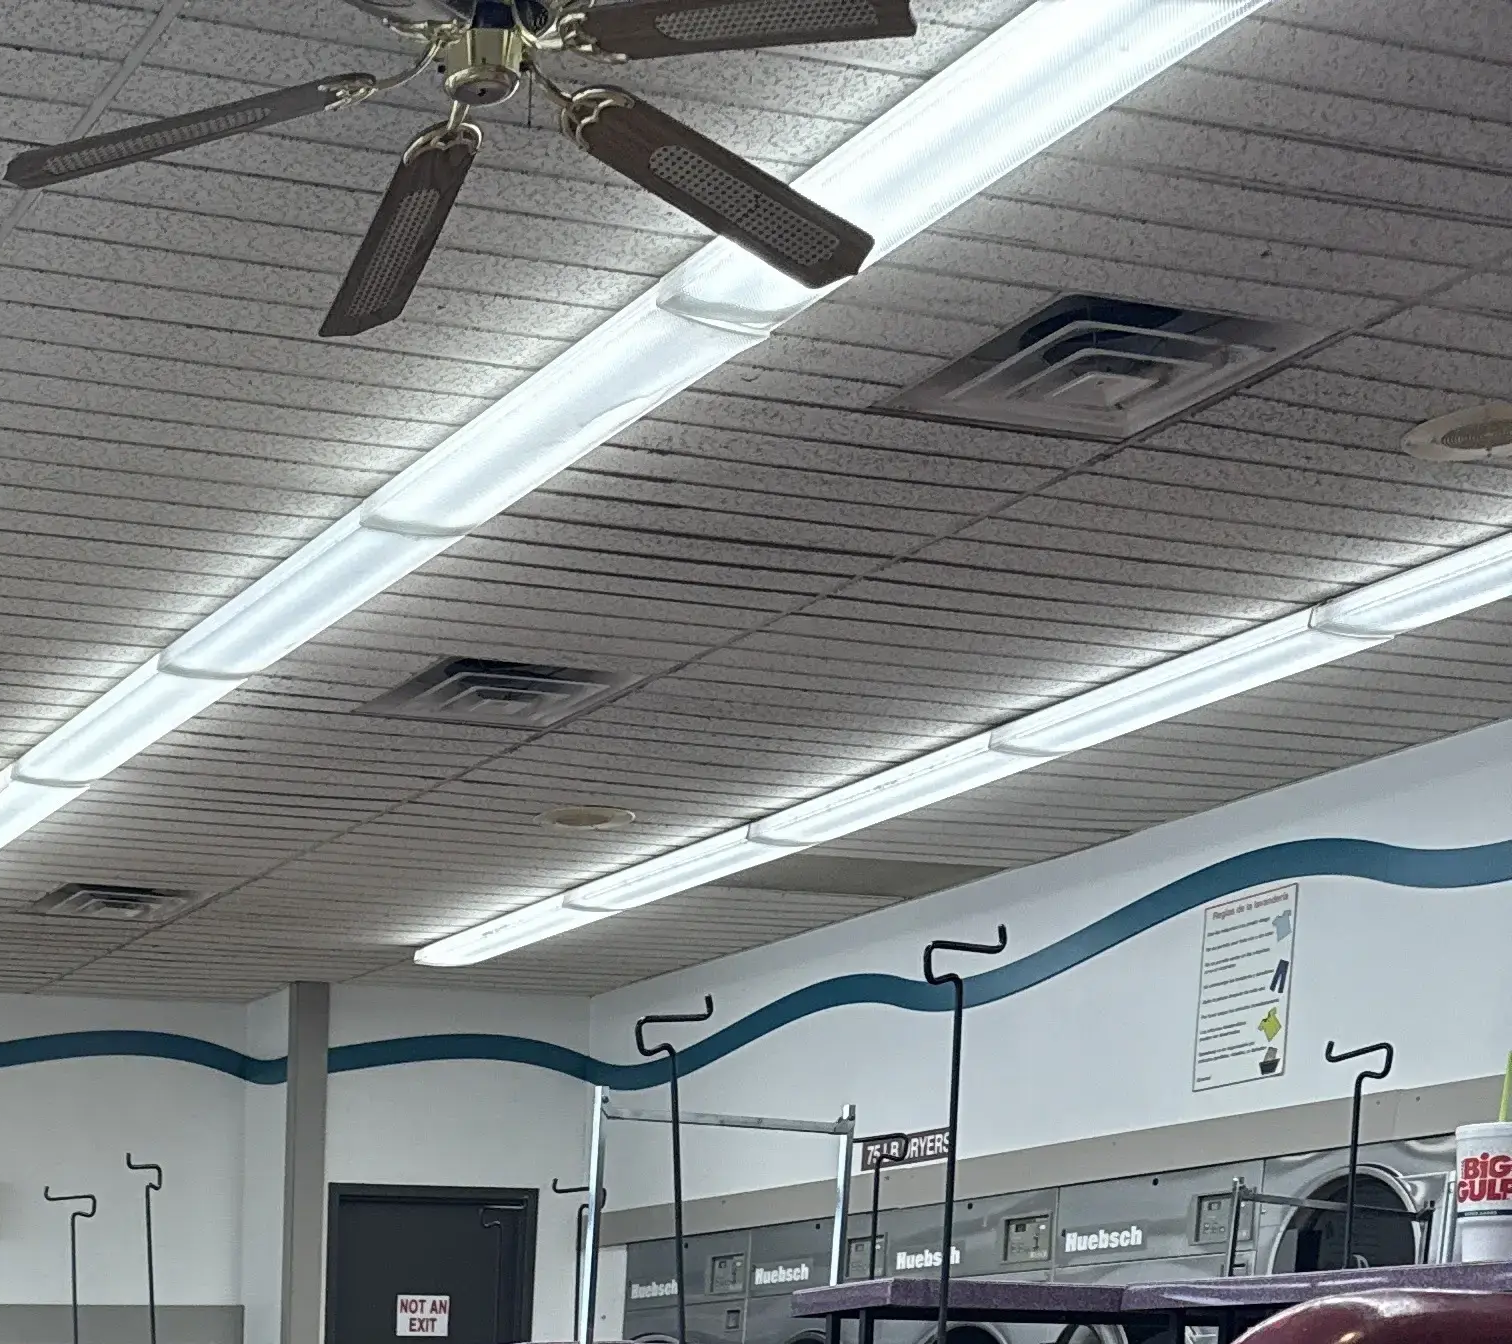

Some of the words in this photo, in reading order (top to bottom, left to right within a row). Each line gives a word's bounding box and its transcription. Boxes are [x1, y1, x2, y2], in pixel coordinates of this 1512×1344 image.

[866, 1144, 881, 1166] 75
[904, 1131, 950, 1160] RYERS
[1065, 1225, 1143, 1253] Huebsch
[895, 1246, 961, 1271] Huebsh
[754, 1263, 810, 1286] Huebsch
[399, 1298, 427, 1314] NOT
[429, 1299, 448, 1315] AN
[408, 1317, 438, 1333] EXIT
